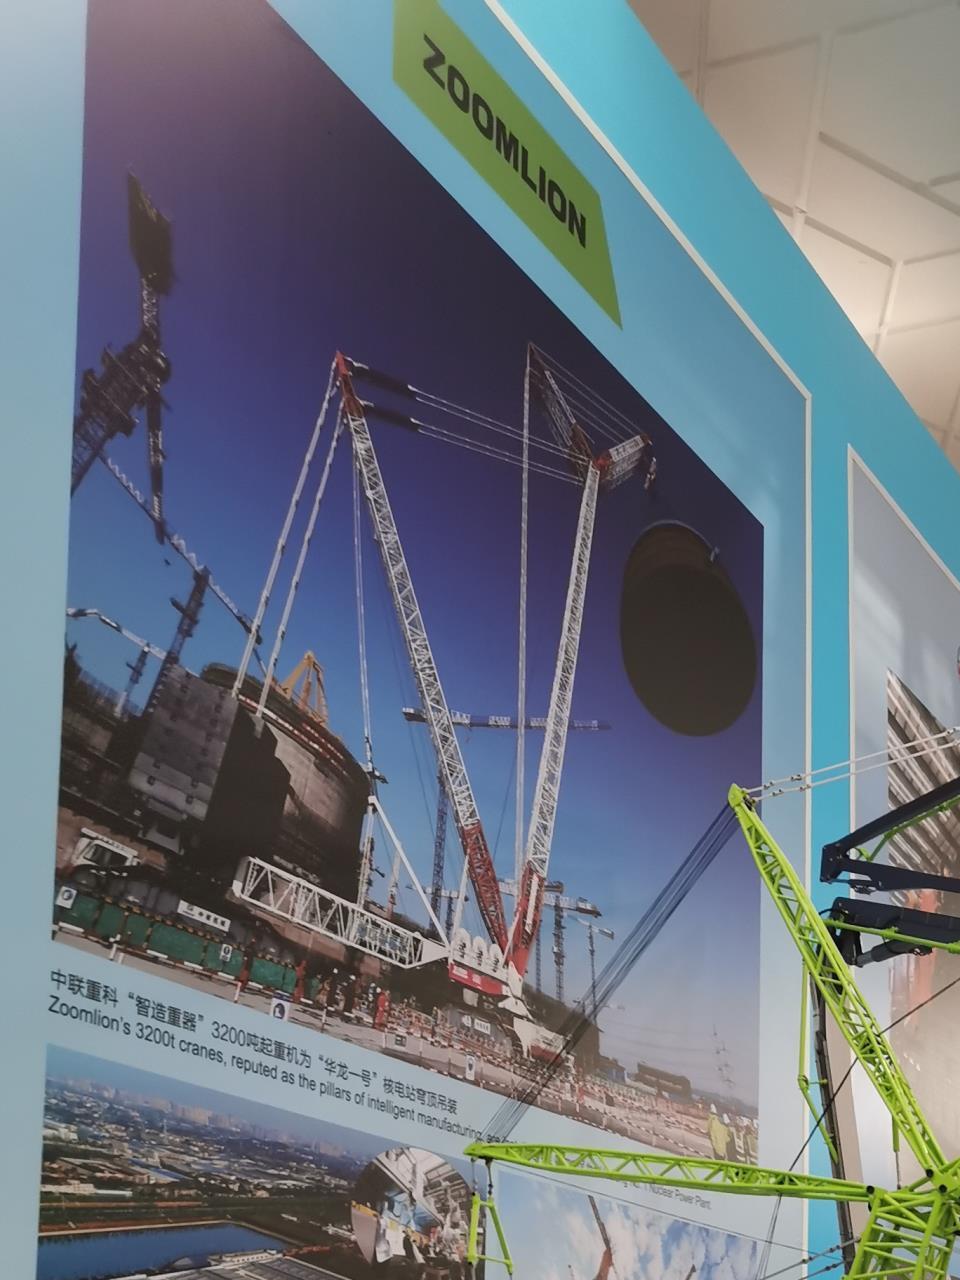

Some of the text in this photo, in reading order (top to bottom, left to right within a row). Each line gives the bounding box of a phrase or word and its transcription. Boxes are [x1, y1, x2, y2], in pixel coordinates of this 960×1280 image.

[423, 33, 586, 248] ZOOMLION
[48, 995, 131, 1036] Zoomlion's
[136, 1022, 176, 1049] 3200t
[179, 1038, 228, 1067] cranes,
[231, 1055, 278, 1080] reputed
[281, 1069, 295, 1084] as
[298, 1073, 316, 1091] the
[319, 1081, 351, 1102] pillars
[354, 1092, 365, 1105] of
[367, 1095, 415, 1121] intelligent
